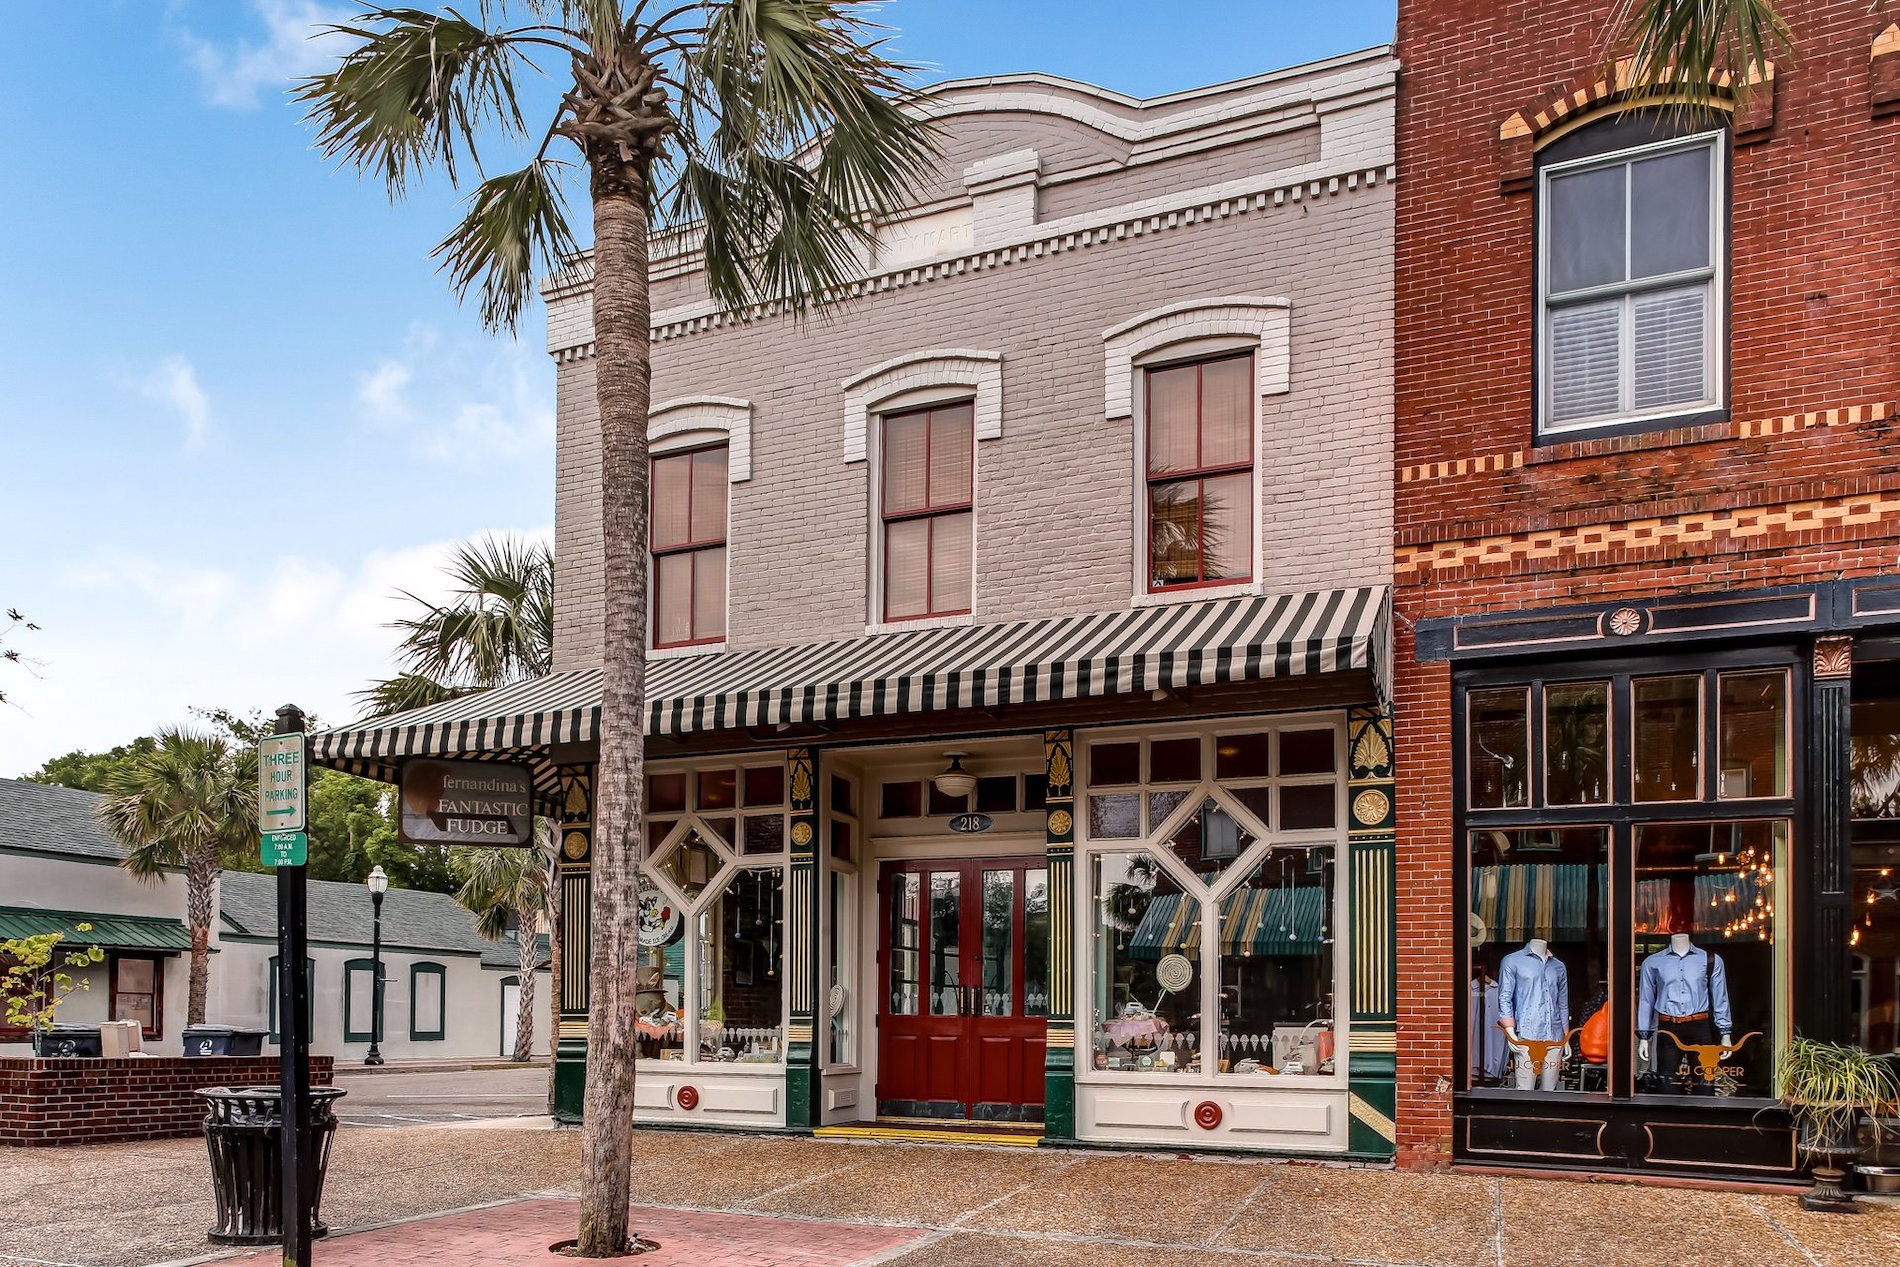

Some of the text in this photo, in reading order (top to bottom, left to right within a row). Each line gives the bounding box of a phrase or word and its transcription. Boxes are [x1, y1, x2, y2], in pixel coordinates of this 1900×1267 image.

[263, 751, 299, 766] THREE
[270, 769, 292, 782] HOUR
[443, 775, 527, 793] fernandina's
[265, 787, 298, 801] PARKING
[438, 799, 529, 817] FANTASTIC
[446, 818, 509, 835] FUDGE
[960, 816, 980, 830] 218
[1523, 1060, 1571, 1071] COOPER
[1693, 1065, 1745, 1077] COOPER
